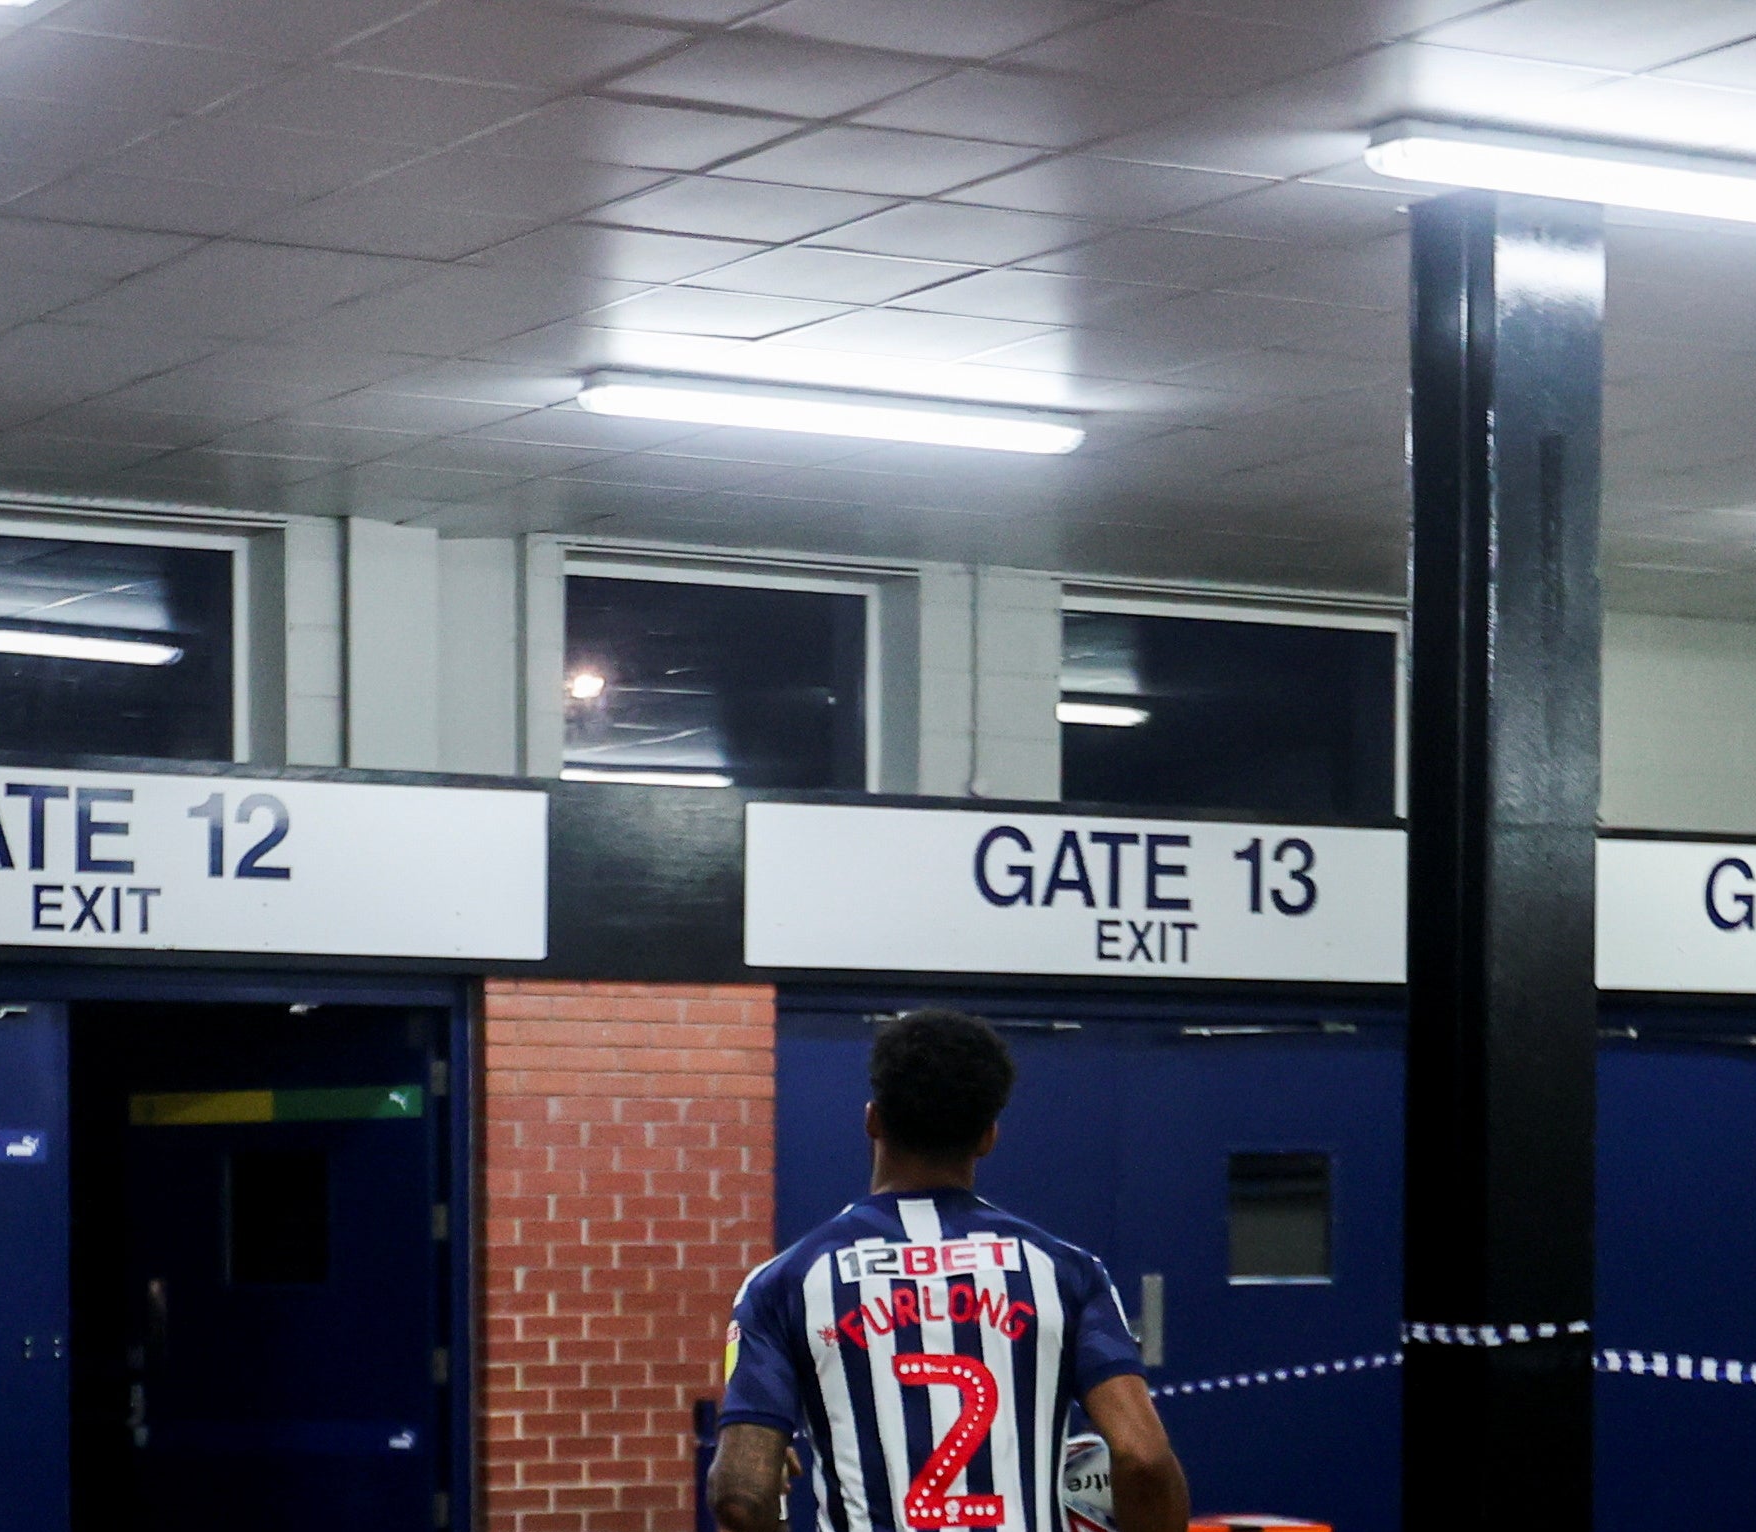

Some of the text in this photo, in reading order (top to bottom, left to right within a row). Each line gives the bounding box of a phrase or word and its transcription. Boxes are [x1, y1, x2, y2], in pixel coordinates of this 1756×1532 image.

[187, 792, 292, 881] 12
[974, 825, 1318, 917] GATE 13
[31, 884, 162, 934] EXIT
[1095, 919, 1199, 964] EXIT
[842, 1241, 1014, 1278] 12BET
[838, 1283, 1036, 1350] FURLONG
[891, 1353, 1005, 1531] 2
